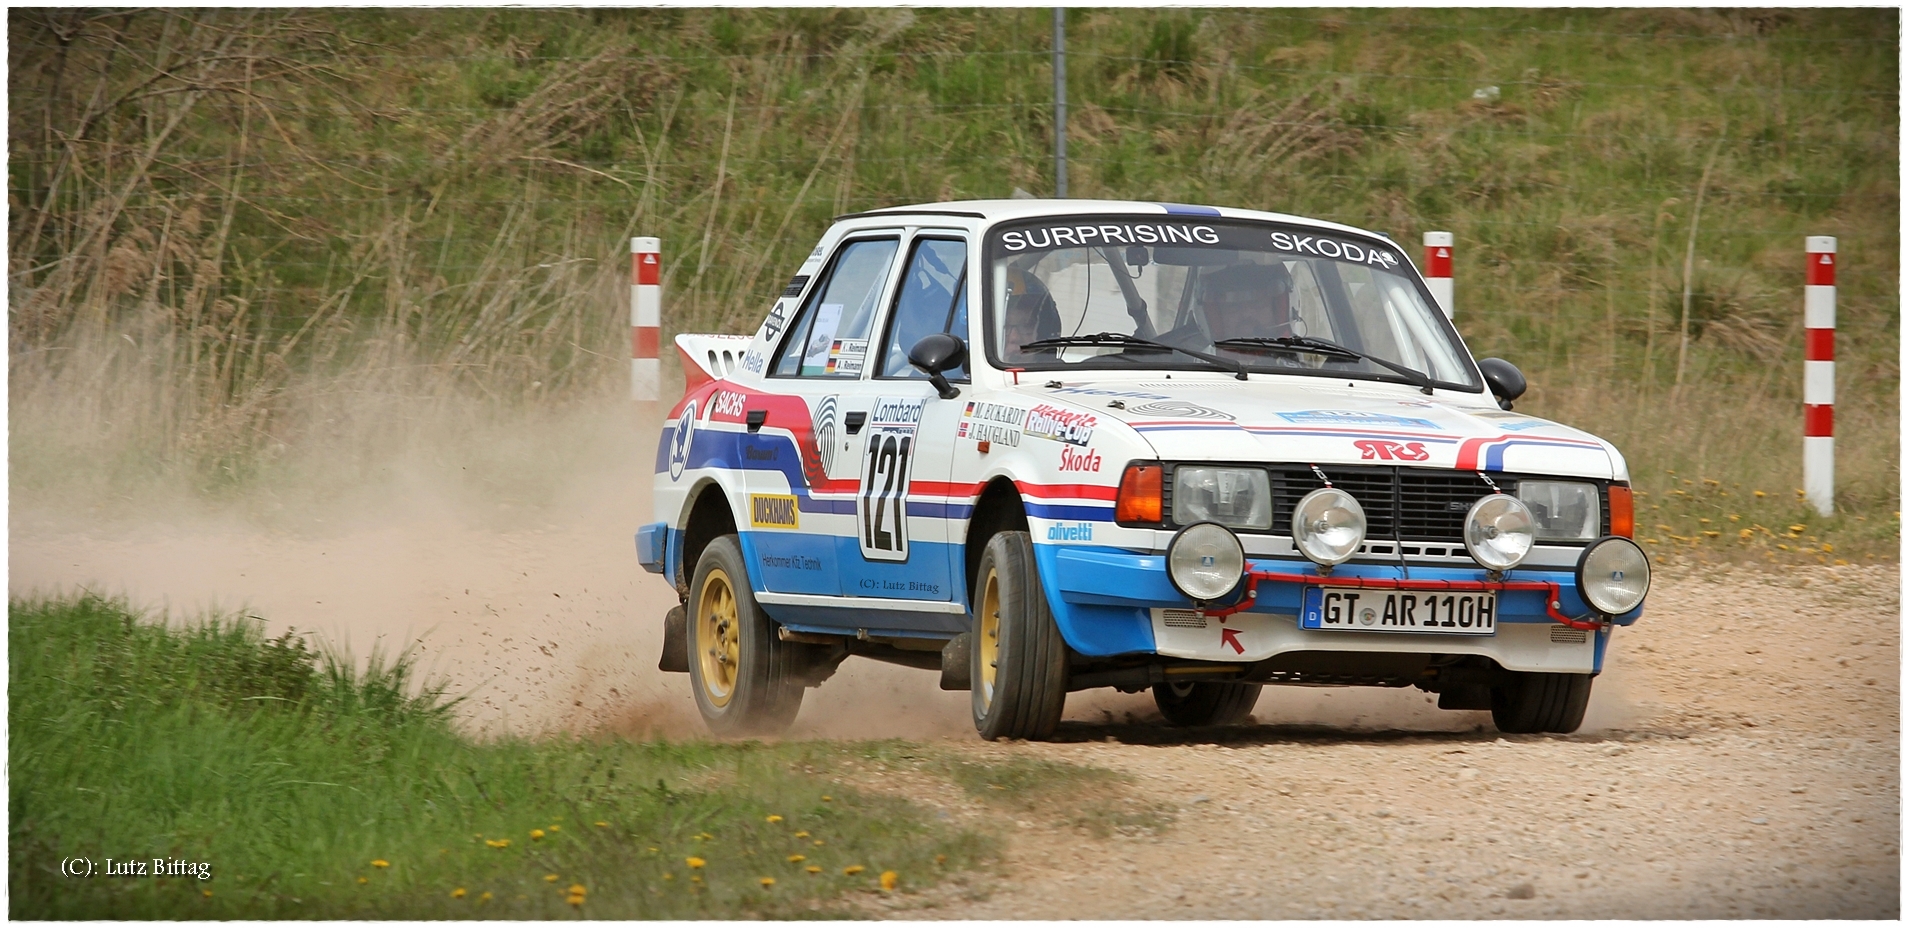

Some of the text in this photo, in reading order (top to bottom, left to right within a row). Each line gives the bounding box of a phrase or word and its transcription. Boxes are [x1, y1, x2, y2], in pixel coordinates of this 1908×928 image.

[1002, 224, 1220, 251] SURPRISING
[1270, 232, 1389, 268] SKODA
[742, 349, 764, 374] Hella
[715, 390, 747, 417] SACHS
[872, 398, 925, 422] Lombard
[984, 404, 1026, 426] ECKARDT
[976, 424, 1021, 447] HAUGLAND
[1027, 411, 1093, 444] Rallye-Cup
[1058, 444, 1102, 472] Škoda
[863, 433, 911, 552] 121
[753, 496, 796, 526] DUCKHAMS
[1047, 522, 1093, 541] olivetti
[761, 553, 823, 571] Herkommer Kfz Technik
[1309, 612, 1317, 621] D
[1323, 593, 1494, 628] GT AR 110H
